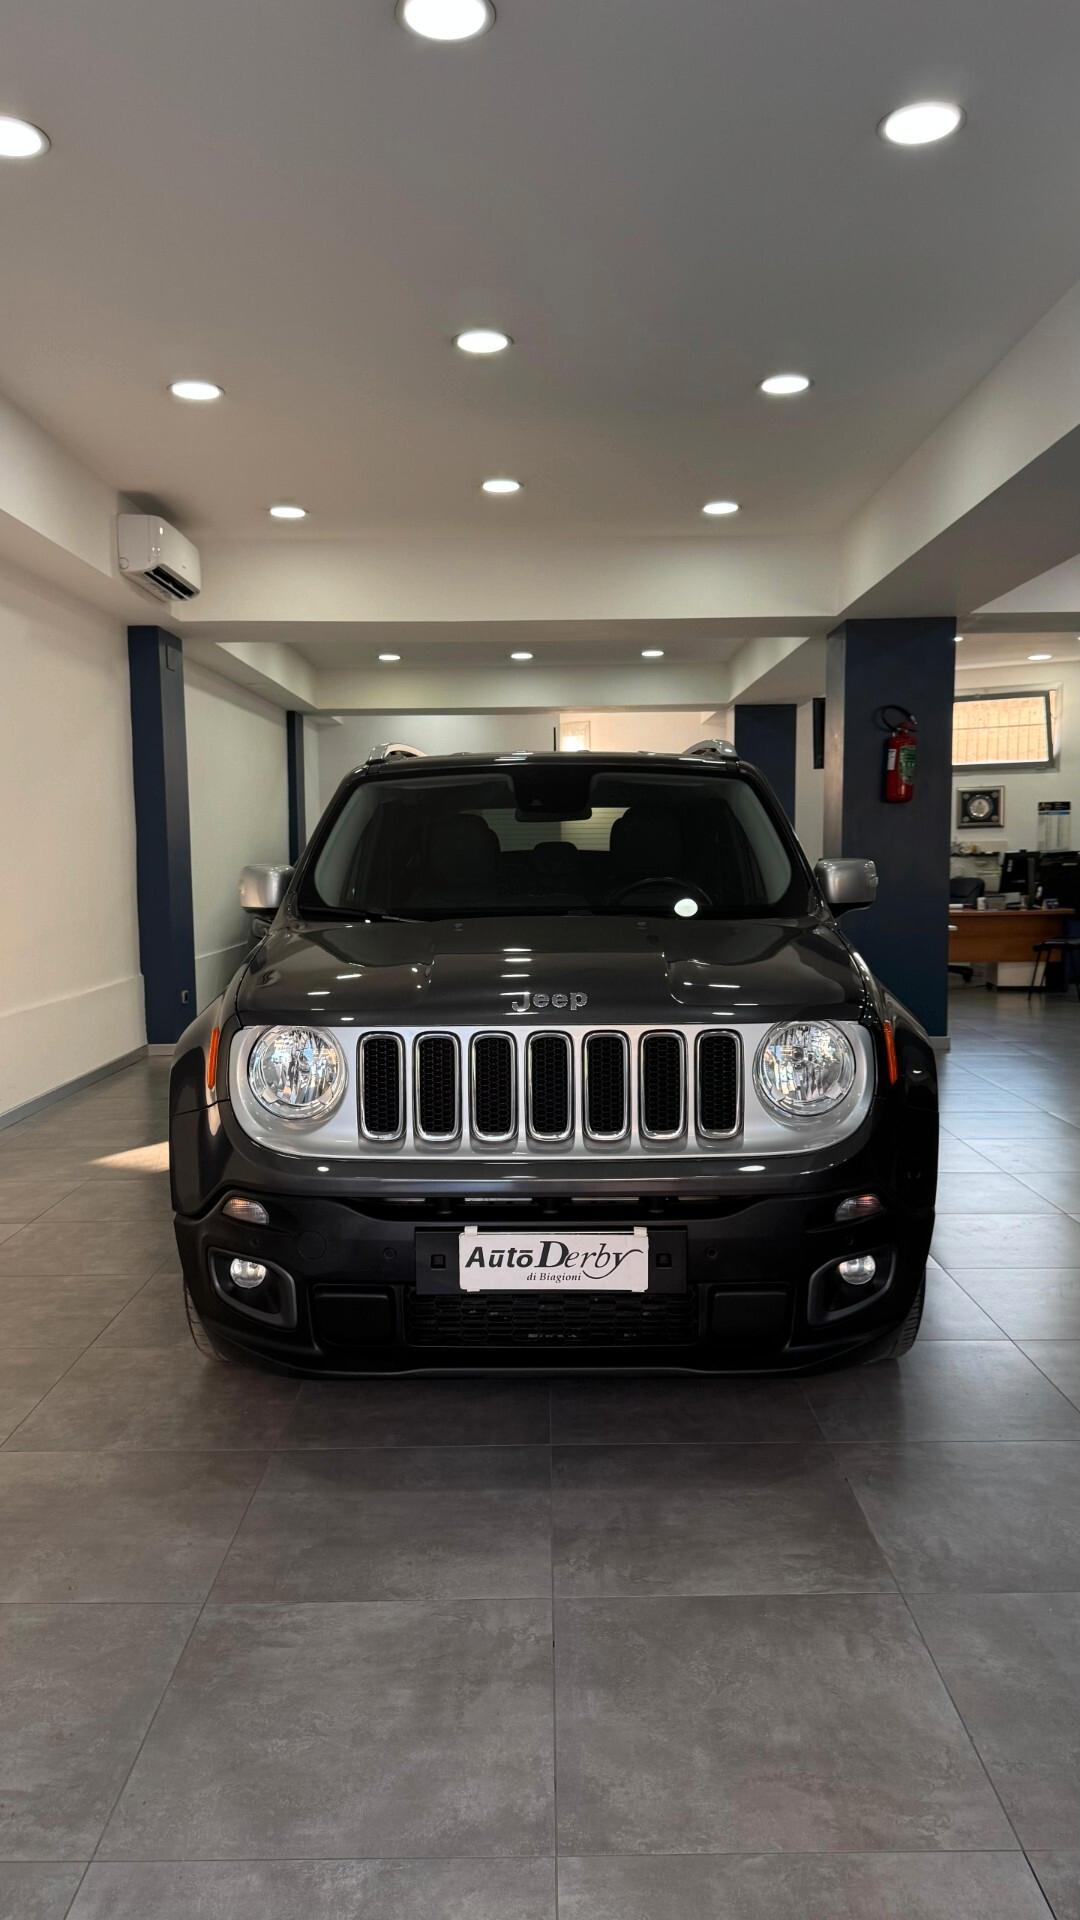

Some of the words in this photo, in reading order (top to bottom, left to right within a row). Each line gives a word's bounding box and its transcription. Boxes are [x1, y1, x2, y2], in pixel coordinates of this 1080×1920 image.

[511, 991, 588, 1012] Jeep
[526, 1272, 537, 1281] di
[539, 1272, 582, 1284] Biagioni
